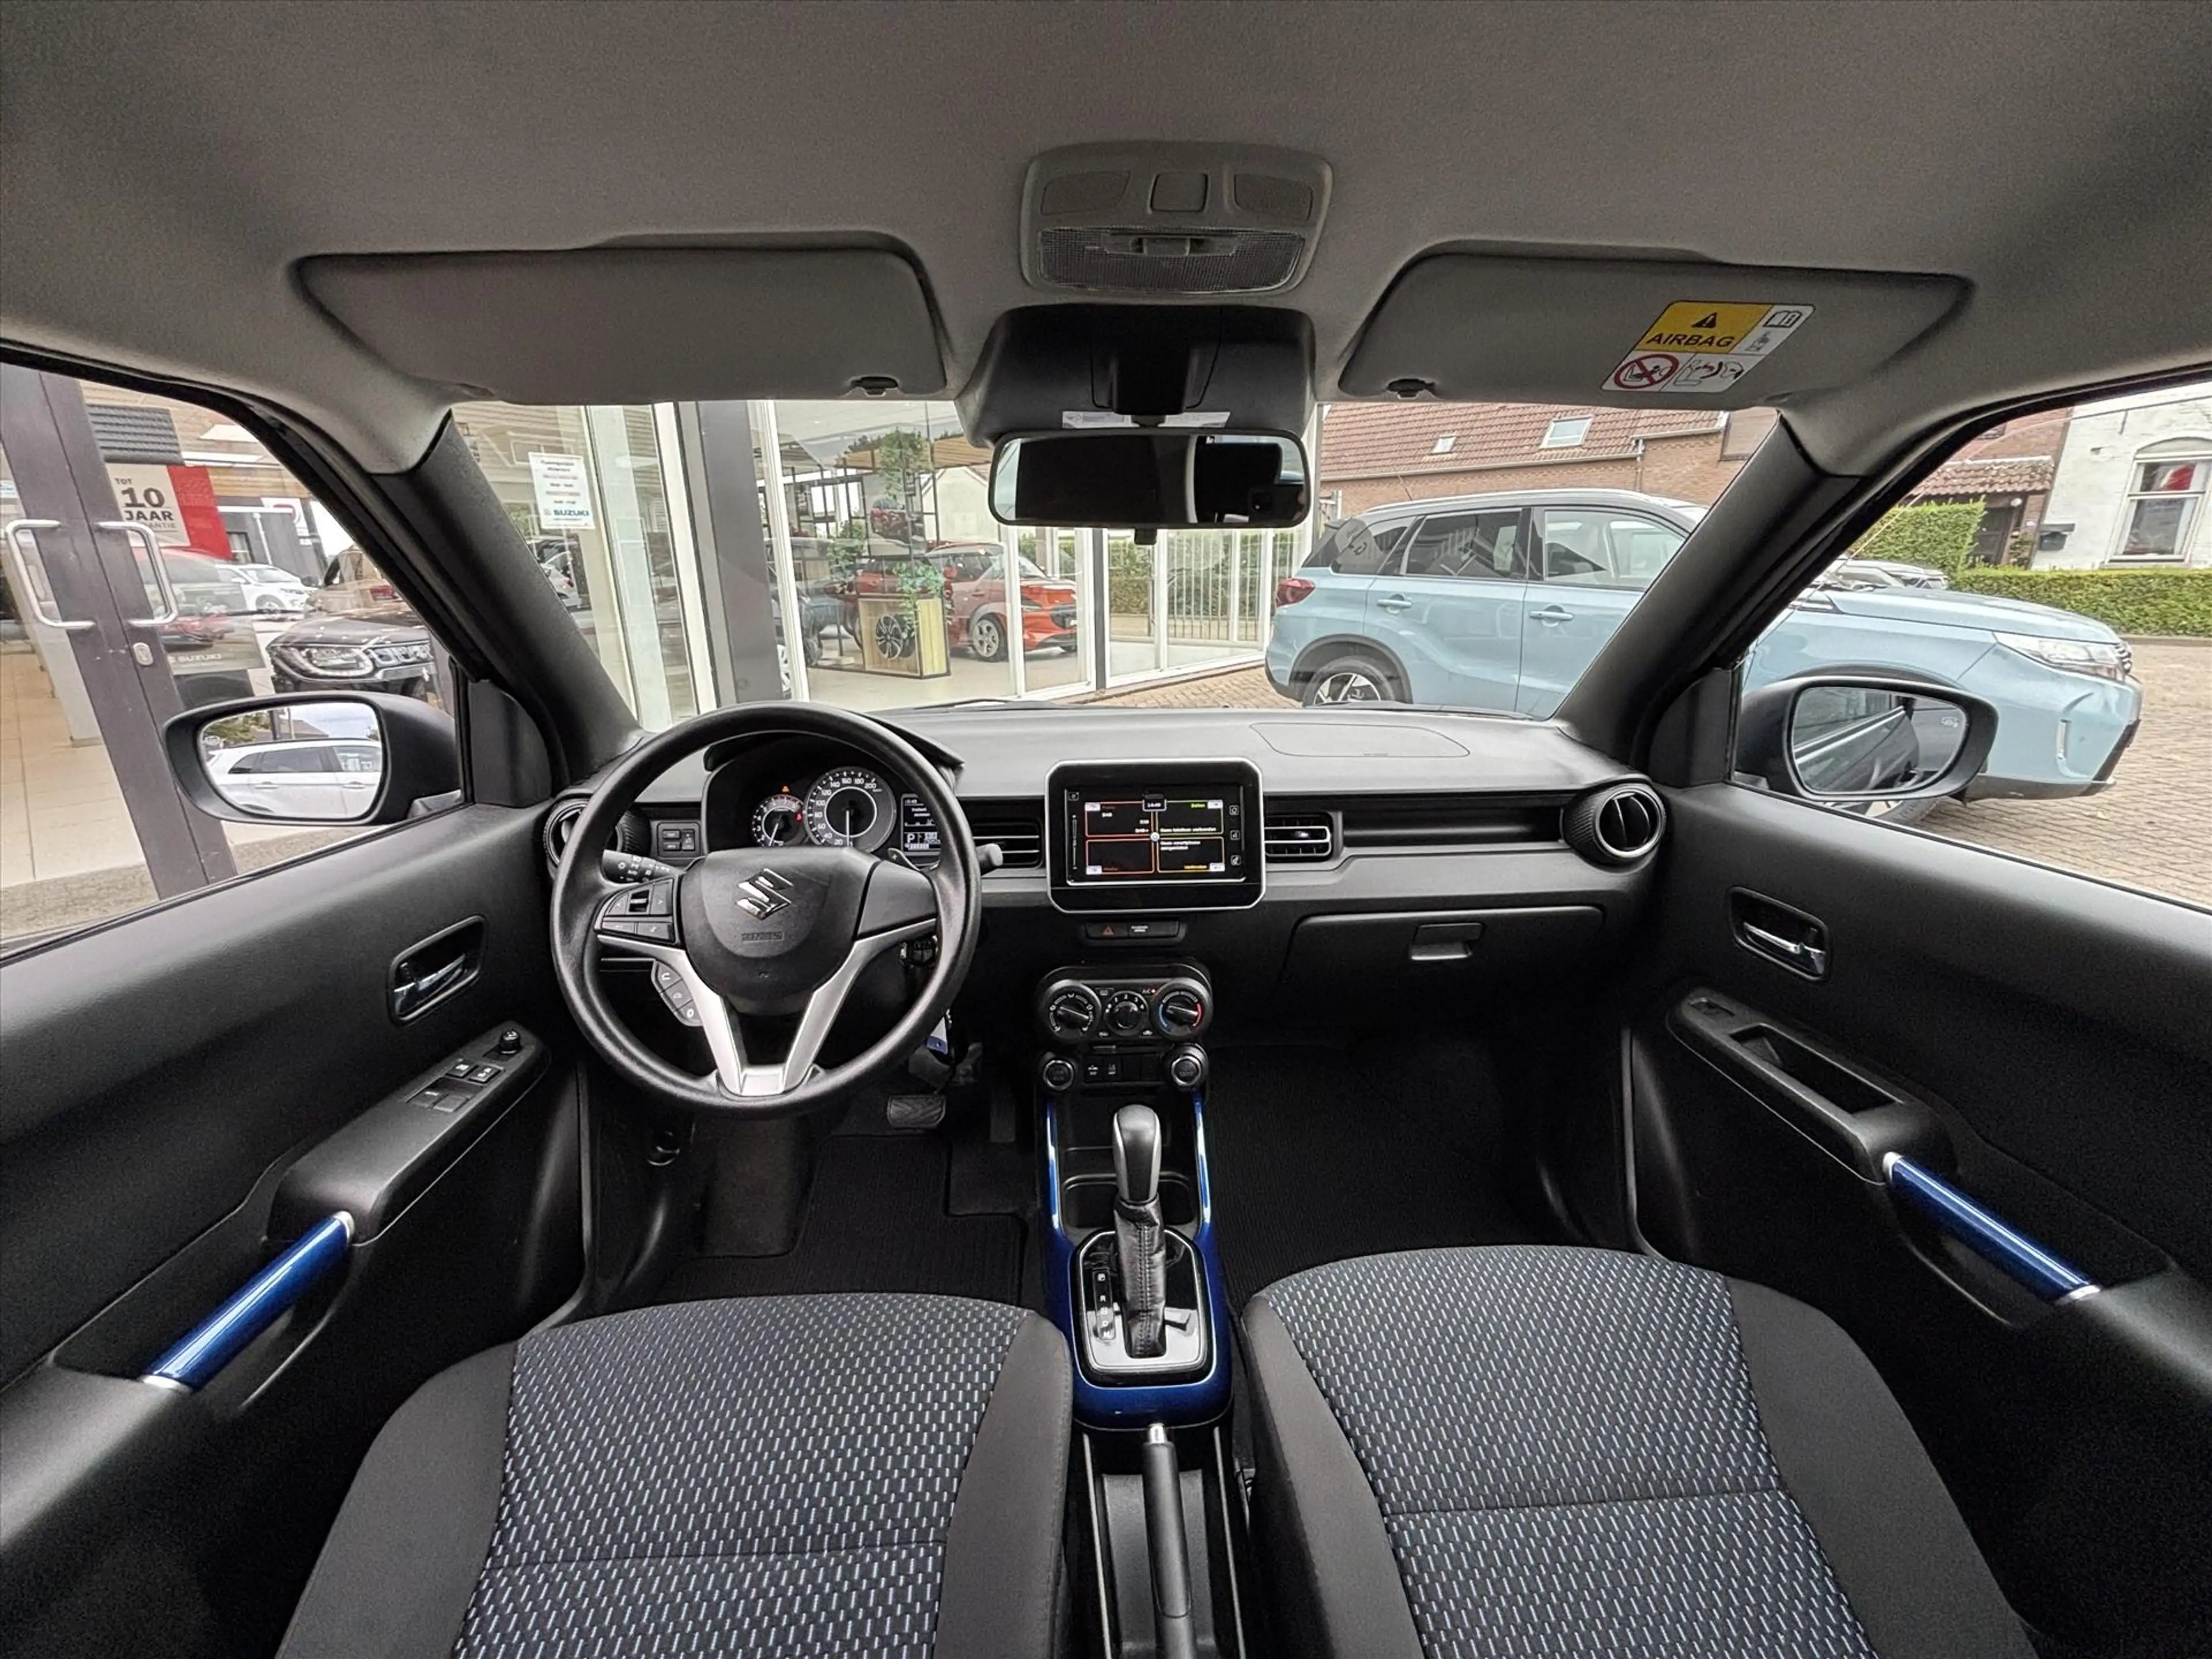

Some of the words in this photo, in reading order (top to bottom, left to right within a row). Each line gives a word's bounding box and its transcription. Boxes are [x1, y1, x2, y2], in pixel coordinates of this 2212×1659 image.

[1646, 332, 1734, 347] AIRBAG
[122, 487, 165, 507] 10
[124, 510, 175, 521] JAAR
[907, 834, 915, 843] P
